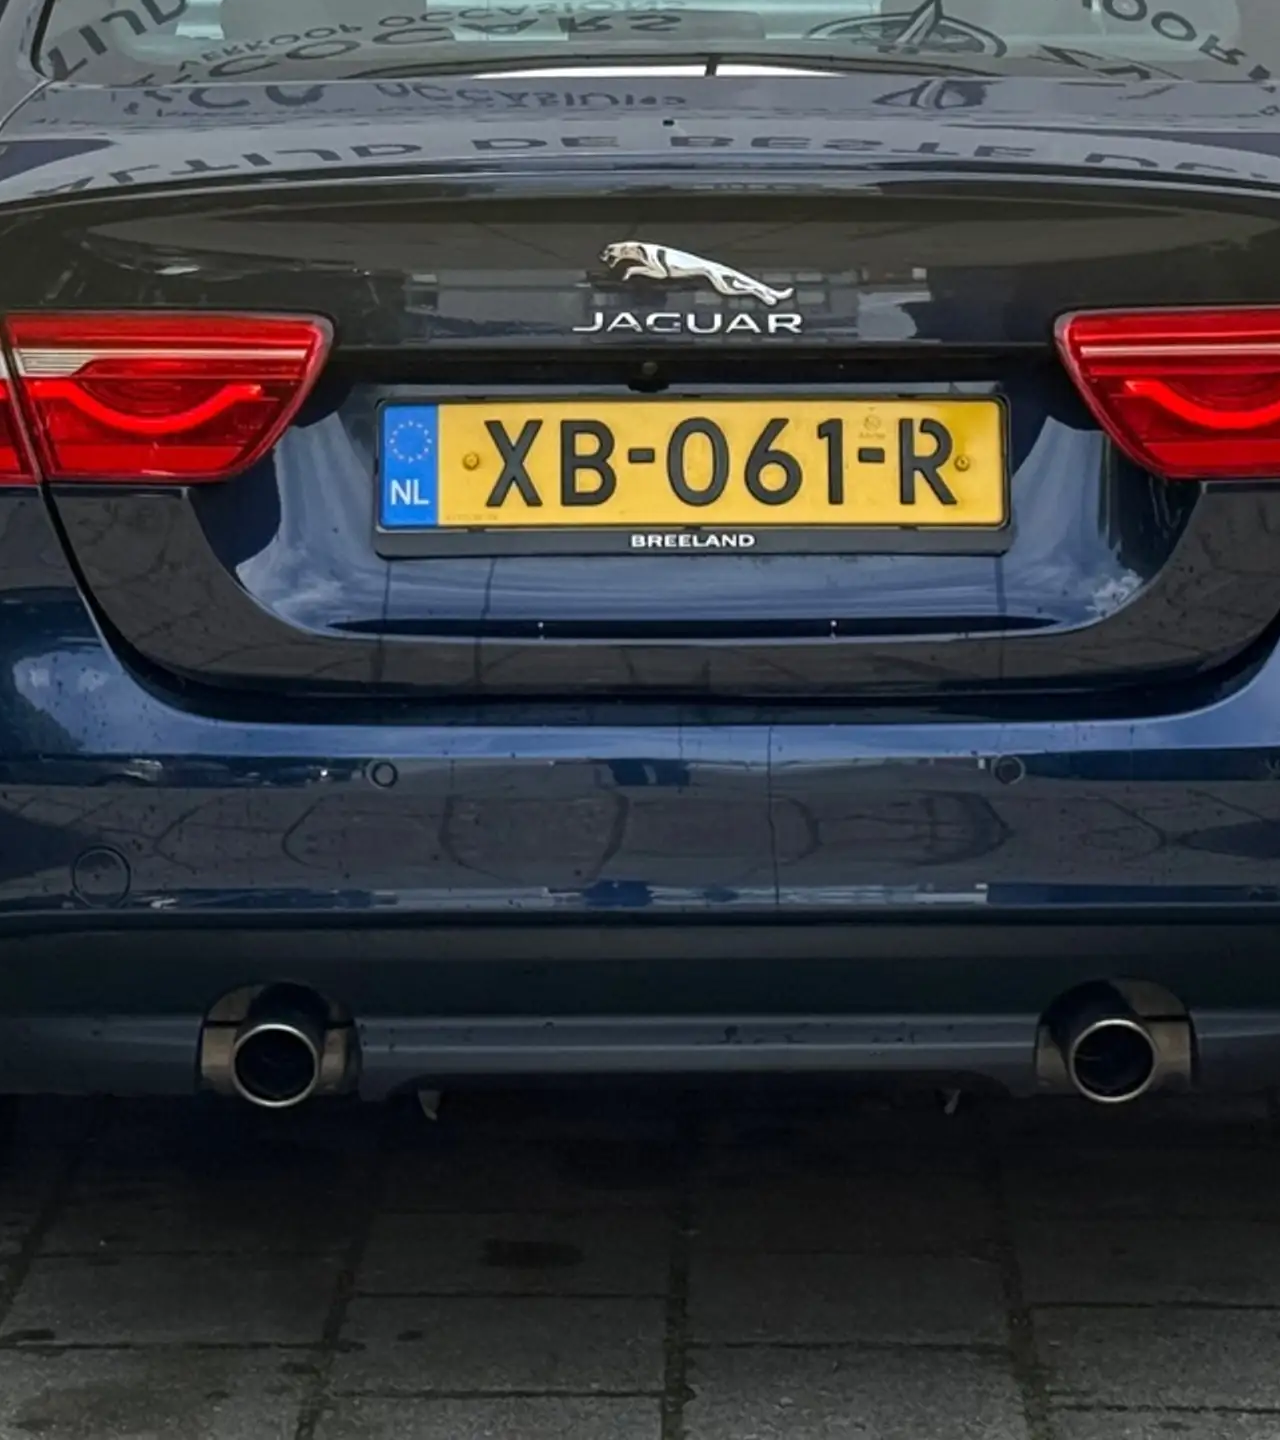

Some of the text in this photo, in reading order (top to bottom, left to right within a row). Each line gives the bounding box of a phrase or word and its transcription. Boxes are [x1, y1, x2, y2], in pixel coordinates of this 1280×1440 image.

[572, 312, 803, 334] JAGUAR
[484, 418, 958, 507] XB-061-R
[390, 479, 430, 506] NL
[630, 533, 756, 548] BREELAND
